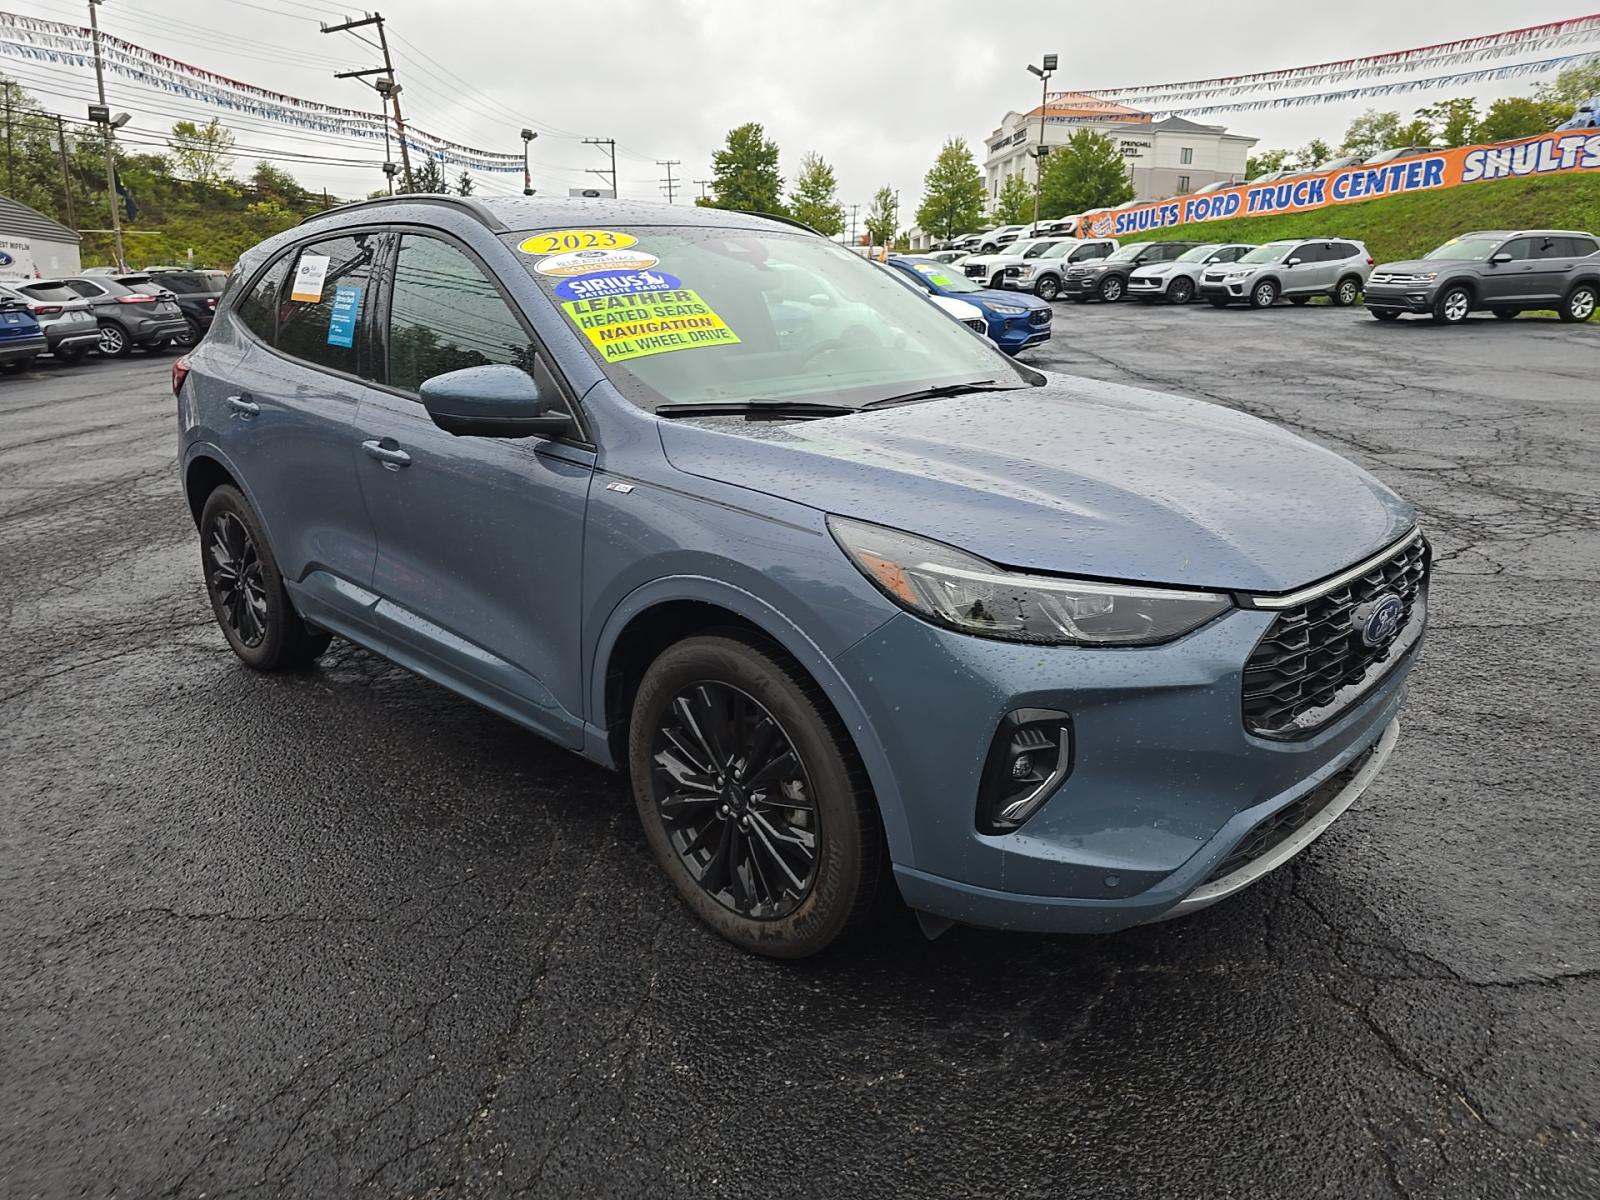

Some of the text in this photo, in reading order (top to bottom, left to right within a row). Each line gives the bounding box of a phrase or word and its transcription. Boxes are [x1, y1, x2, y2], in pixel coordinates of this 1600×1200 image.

[1462, 134, 1600, 182] SHULTS
[1115, 204, 1179, 234] SHULTS
[1185, 193, 1240, 222] FORD
[1247, 178, 1326, 212] TRUCK
[1332, 159, 1445, 200] CENTER
[544, 232, 617, 252] 2023
[568, 273, 643, 295] SIRIUS
[578, 283, 670, 299] SATELLITE RADIO
[573, 291, 692, 315] LEATHER
[581, 303, 707, 329] HEATED SEATS
[599, 317, 713, 341] NAVIGATION
[606, 328, 730, 357] ALL WHEEL DRIVE
